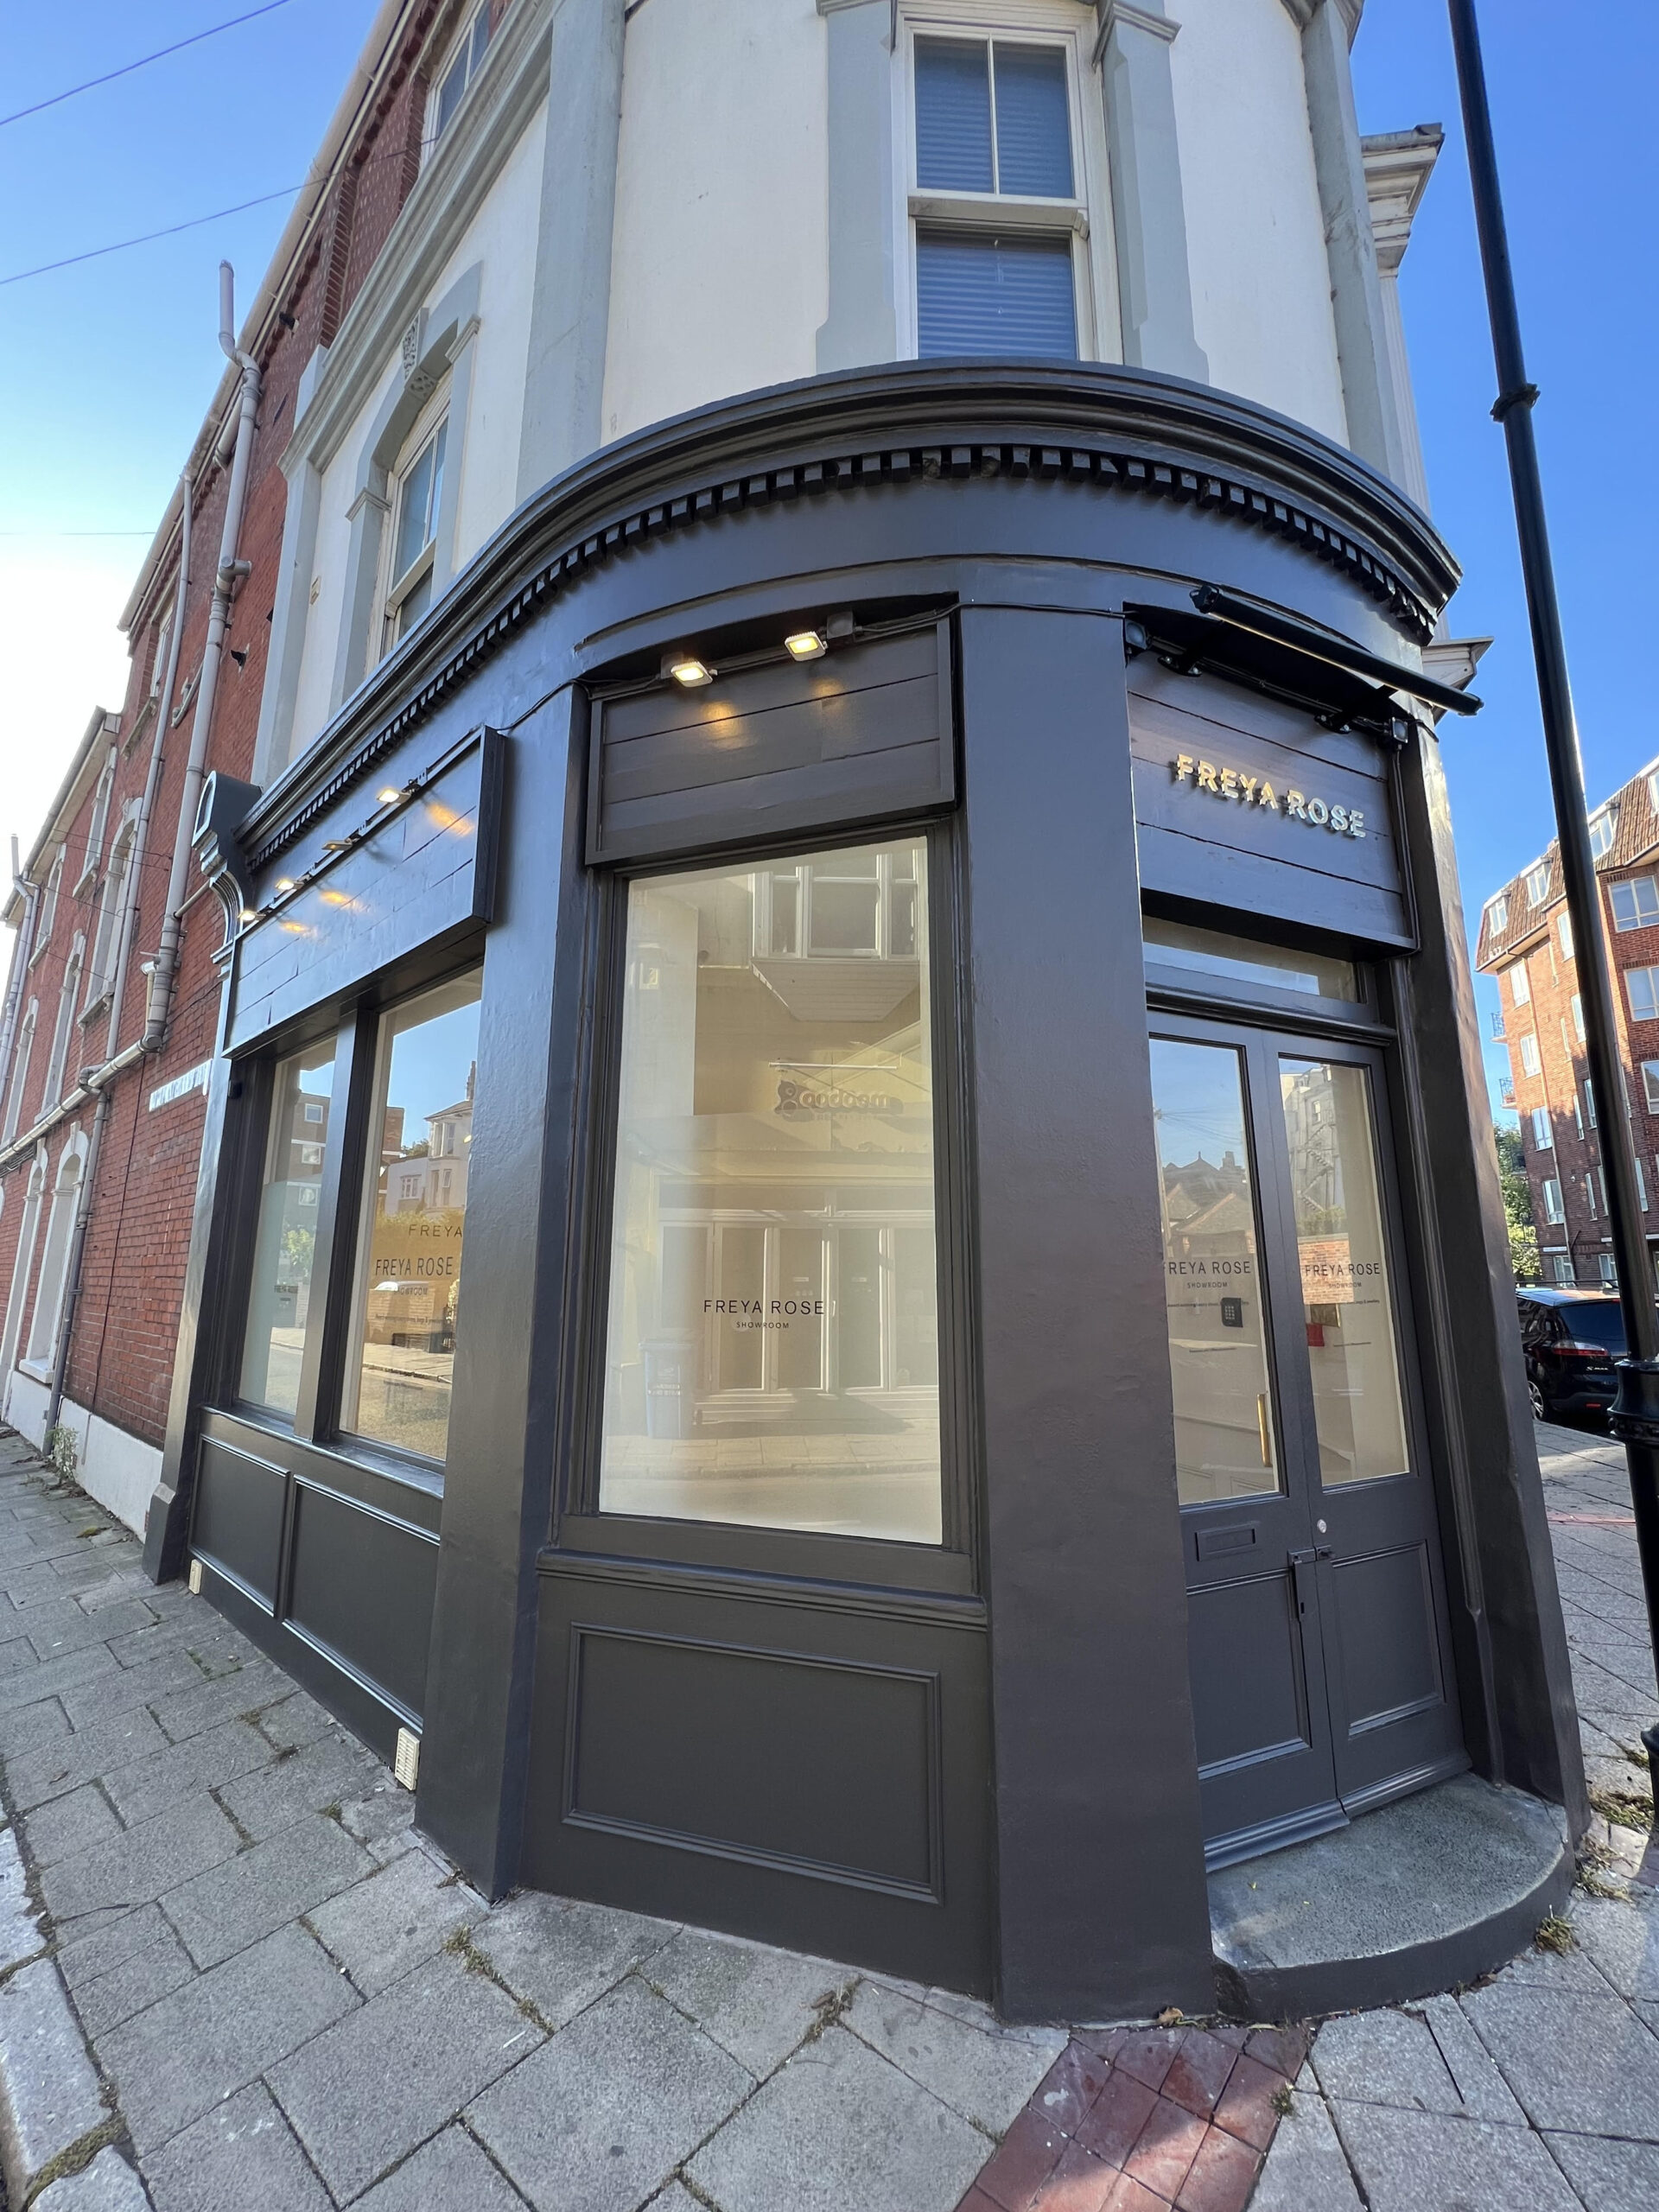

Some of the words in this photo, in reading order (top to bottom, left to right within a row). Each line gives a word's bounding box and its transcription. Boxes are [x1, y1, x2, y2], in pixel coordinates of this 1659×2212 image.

[1176, 753, 1279, 810] FREYA
[1287, 790, 1366, 838] ROSE
[408, 1224, 463, 1238] FREYA
[375, 1259, 411, 1276] FREYA
[416, 1256, 454, 1276] ROSE
[1164, 1262, 1206, 1274] REYA
[1212, 1261, 1251, 1274] ROSE
[1305, 1264, 1344, 1276] FREYA
[1349, 1263, 1381, 1275] ROSE
[703, 1300, 762, 1313] FREYA
[771, 1300, 825, 1315] ROSE
